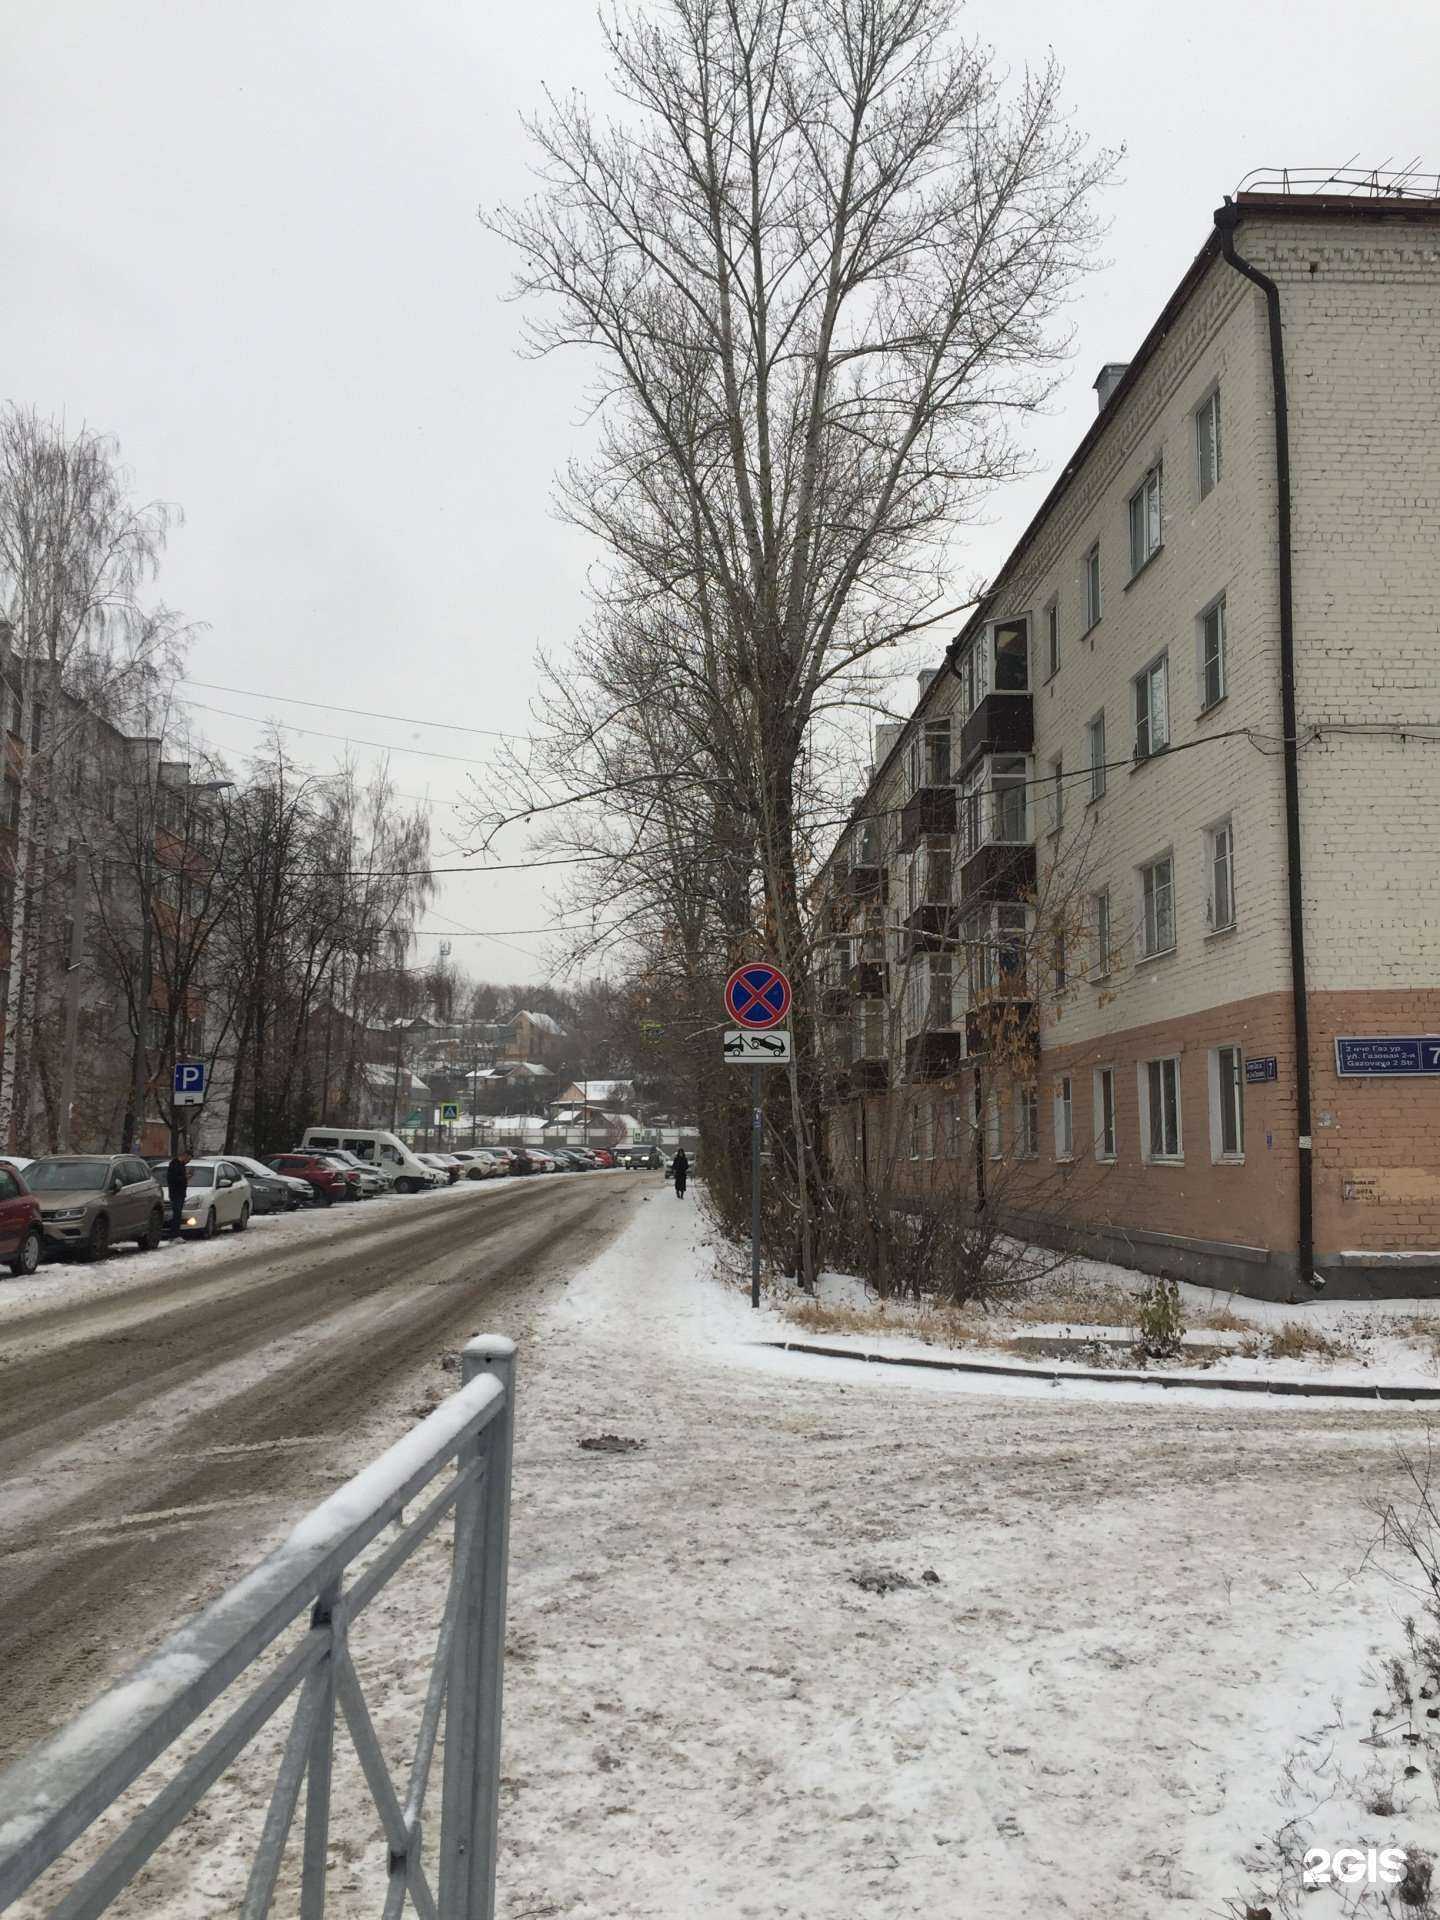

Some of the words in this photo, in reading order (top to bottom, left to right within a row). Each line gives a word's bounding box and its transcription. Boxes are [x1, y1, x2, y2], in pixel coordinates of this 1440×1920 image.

[1347, 1060, 1391, 1068] Gazovaya
[1428, 1047, 1440, 1065] 7
[182, 1067, 199, 1090] P
